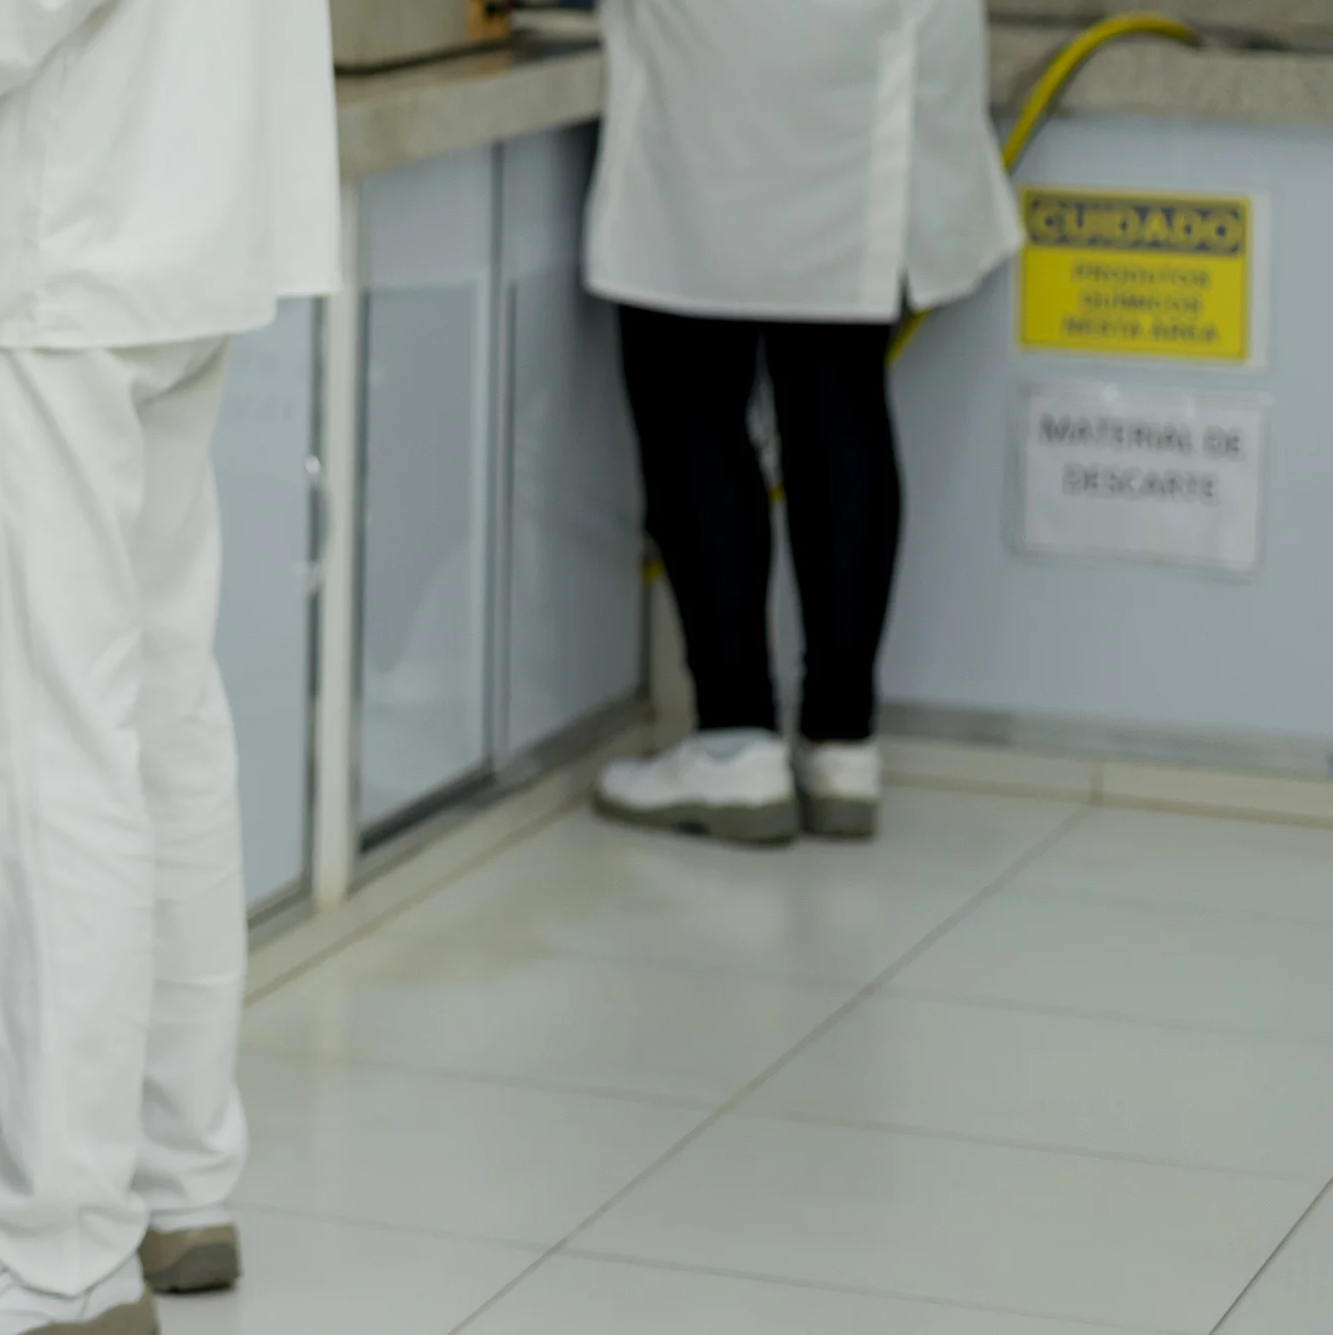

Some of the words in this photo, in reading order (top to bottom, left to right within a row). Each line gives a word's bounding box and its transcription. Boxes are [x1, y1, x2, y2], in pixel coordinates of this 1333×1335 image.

[1031, 201, 1243, 254] CUIDADO
[1039, 413, 1195, 456] MATERIAL
[1204, 425, 1245, 460] DE
[1062, 463, 1218, 504] DESCARTE
